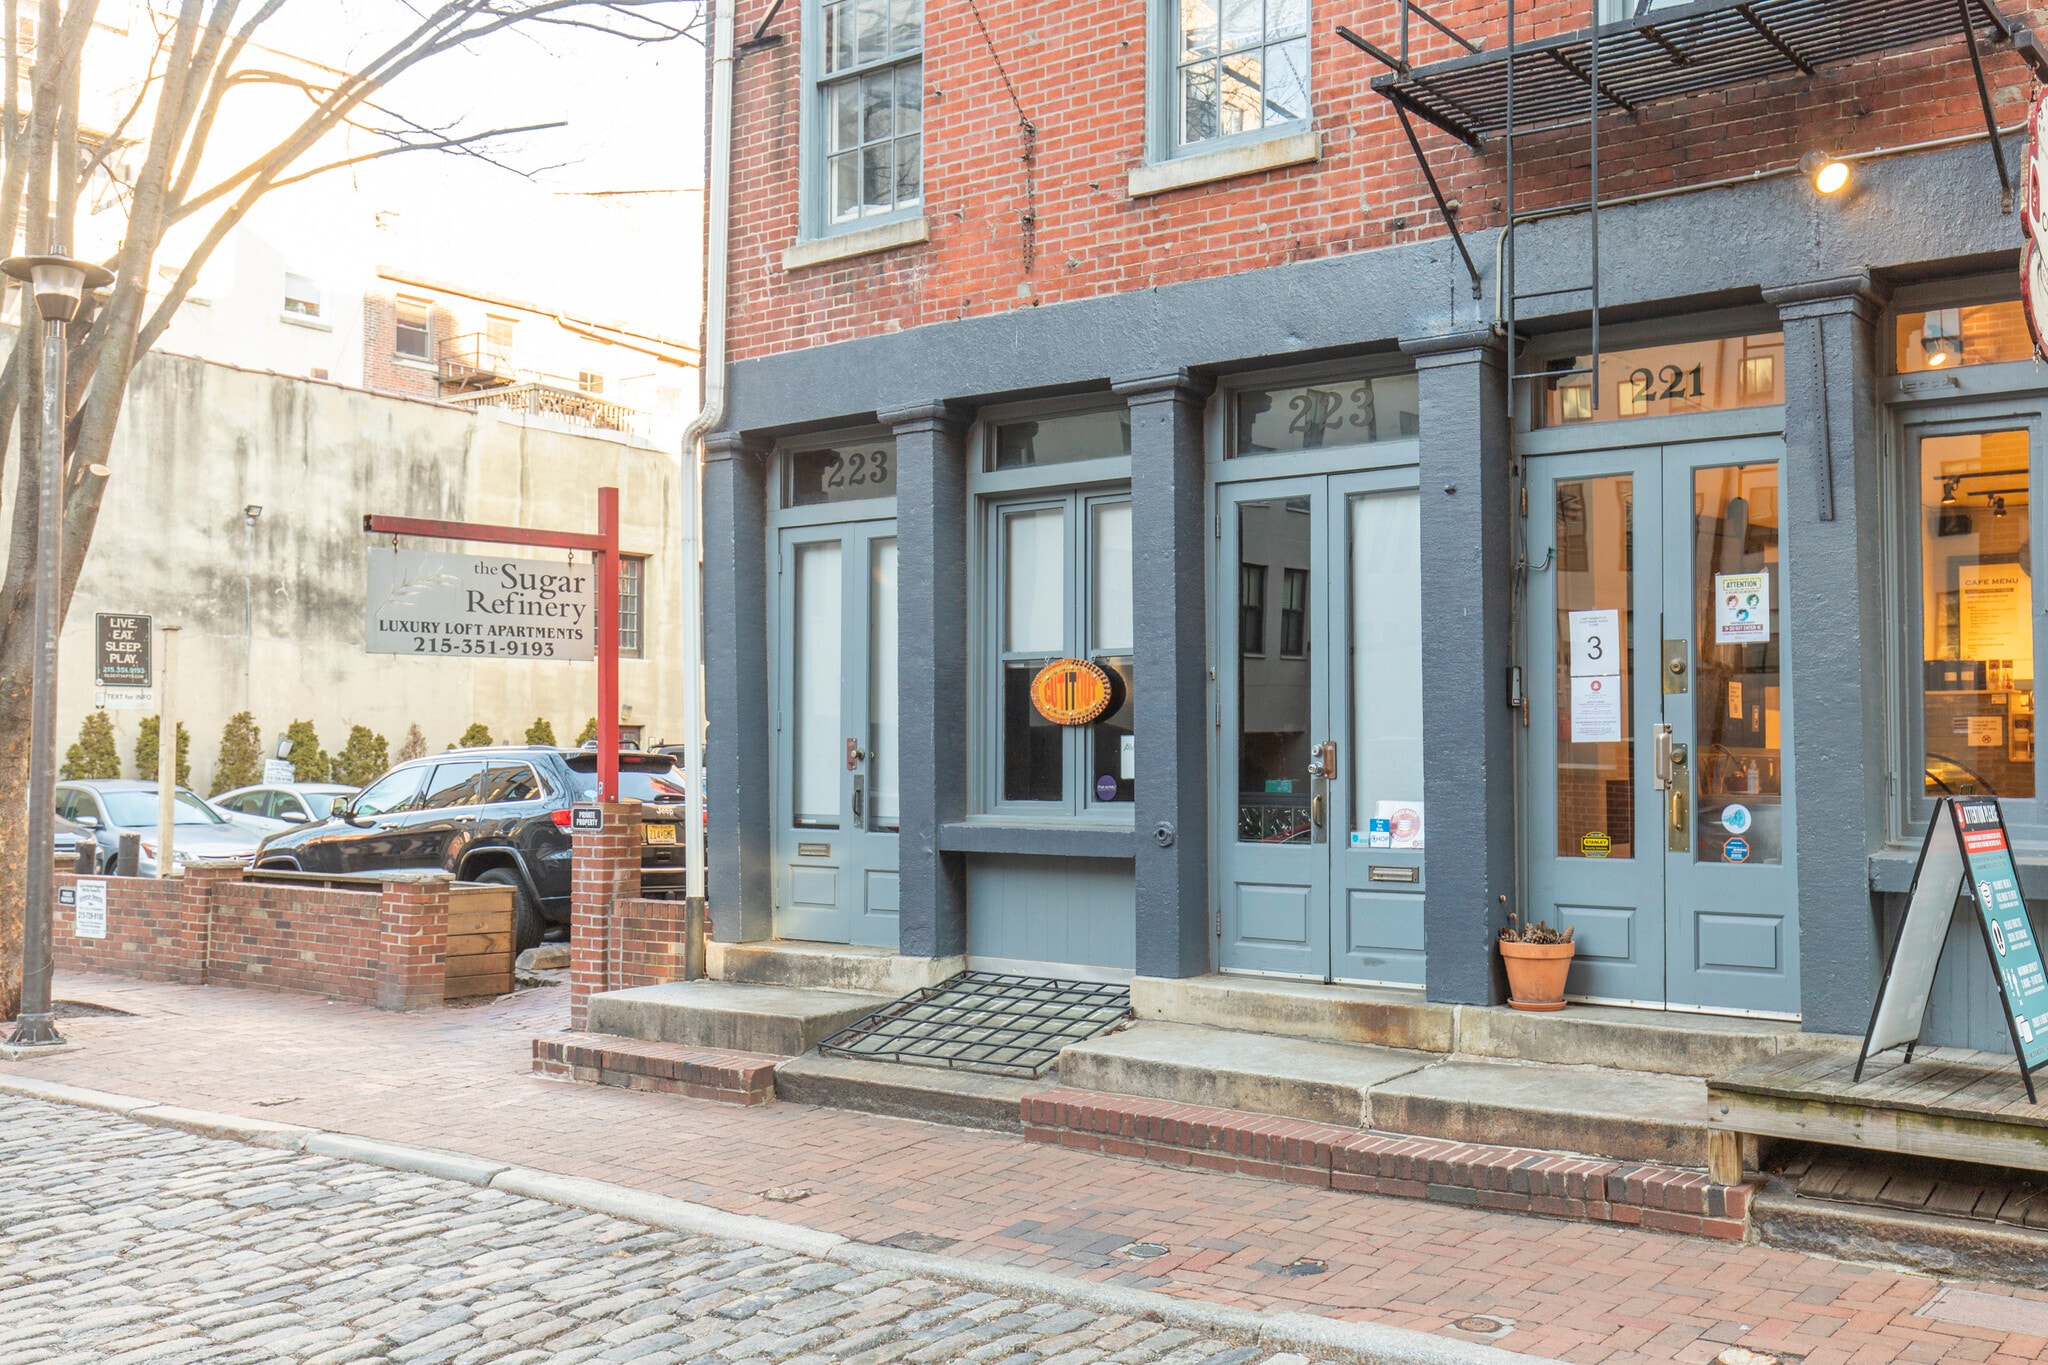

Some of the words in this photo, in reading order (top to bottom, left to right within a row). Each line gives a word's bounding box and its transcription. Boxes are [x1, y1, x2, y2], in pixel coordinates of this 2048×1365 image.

[1629, 361, 1706, 404] 221
[1288, 387, 1375, 434] 223
[828, 450, 888, 488] 223
[474, 561, 498, 576] the
[501, 563, 586, 600] Sugar
[1726, 580, 1757, 589] ATTENTION
[465, 589, 587, 625] Refinery
[110, 618, 138, 629] LIVE.
[379, 619, 441, 634] LUXURY
[445, 623, 484, 637] LOFT
[487, 625, 583, 640] APARTMENTS
[112, 630, 135, 641] EAT.
[105, 641, 143, 653] SLEEP.
[413, 636, 555, 657] 215-351-9193
[1587, 635, 1603, 660] 3
[109, 653, 139, 664] PLAY.
[576, 818, 598, 826] PROPERTY
[656, 807, 674, 816] Jeep
